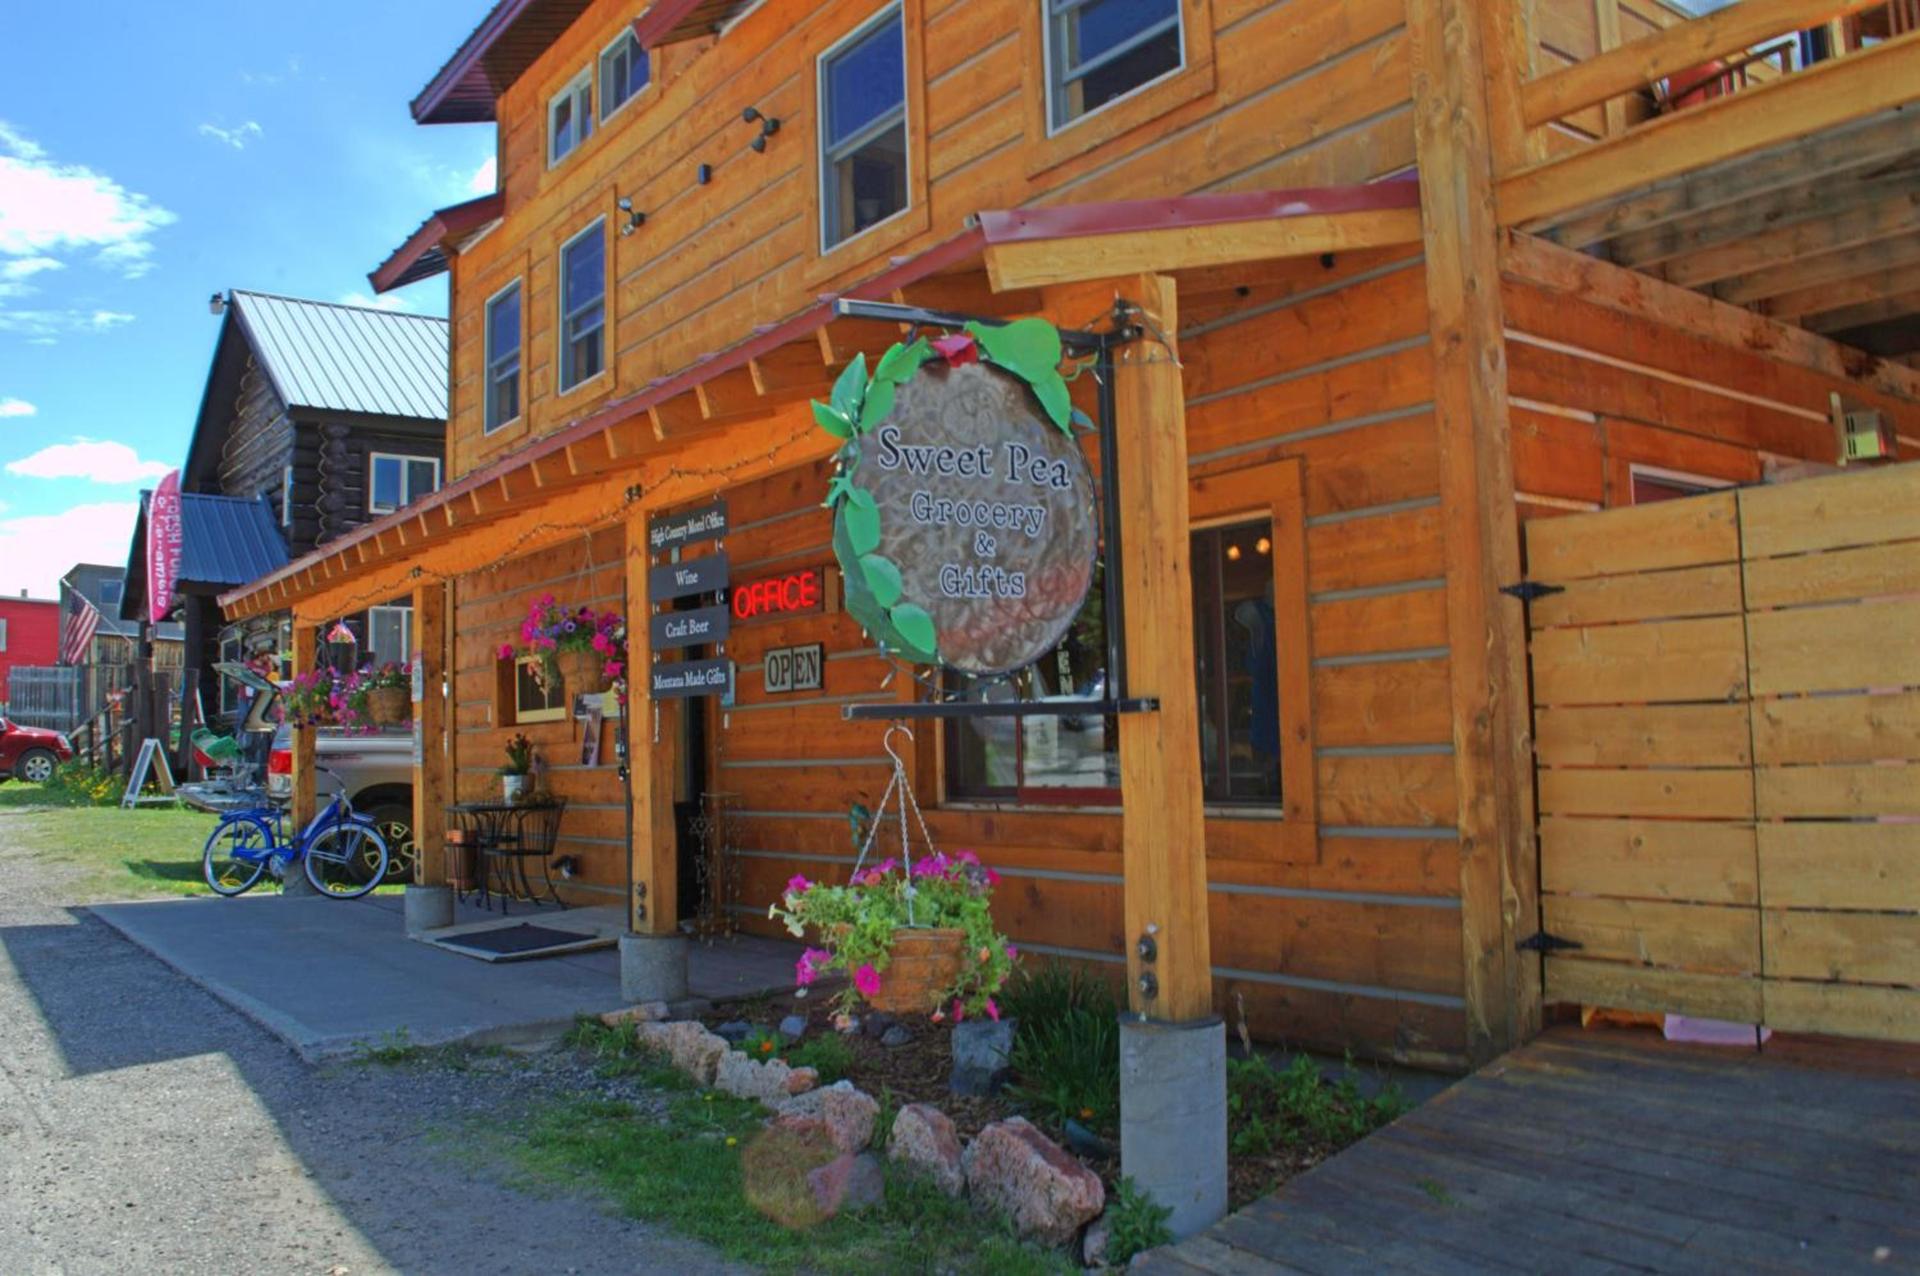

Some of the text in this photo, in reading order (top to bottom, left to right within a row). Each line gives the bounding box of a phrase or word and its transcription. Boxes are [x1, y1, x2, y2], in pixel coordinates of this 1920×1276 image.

[879, 427, 1070, 488] Sweet Pea
[912, 489, 1045, 536] Grocery
[975, 530, 996, 557] &
[675, 569, 699, 586] Wine
[940, 564, 1026, 598] Gifts
[734, 572, 815, 618] OFFICE
[665, 619, 710, 638] Craft Beer
[653, 666, 726, 690] Montana Made Gifts
[767, 650, 818, 687] OPEN
